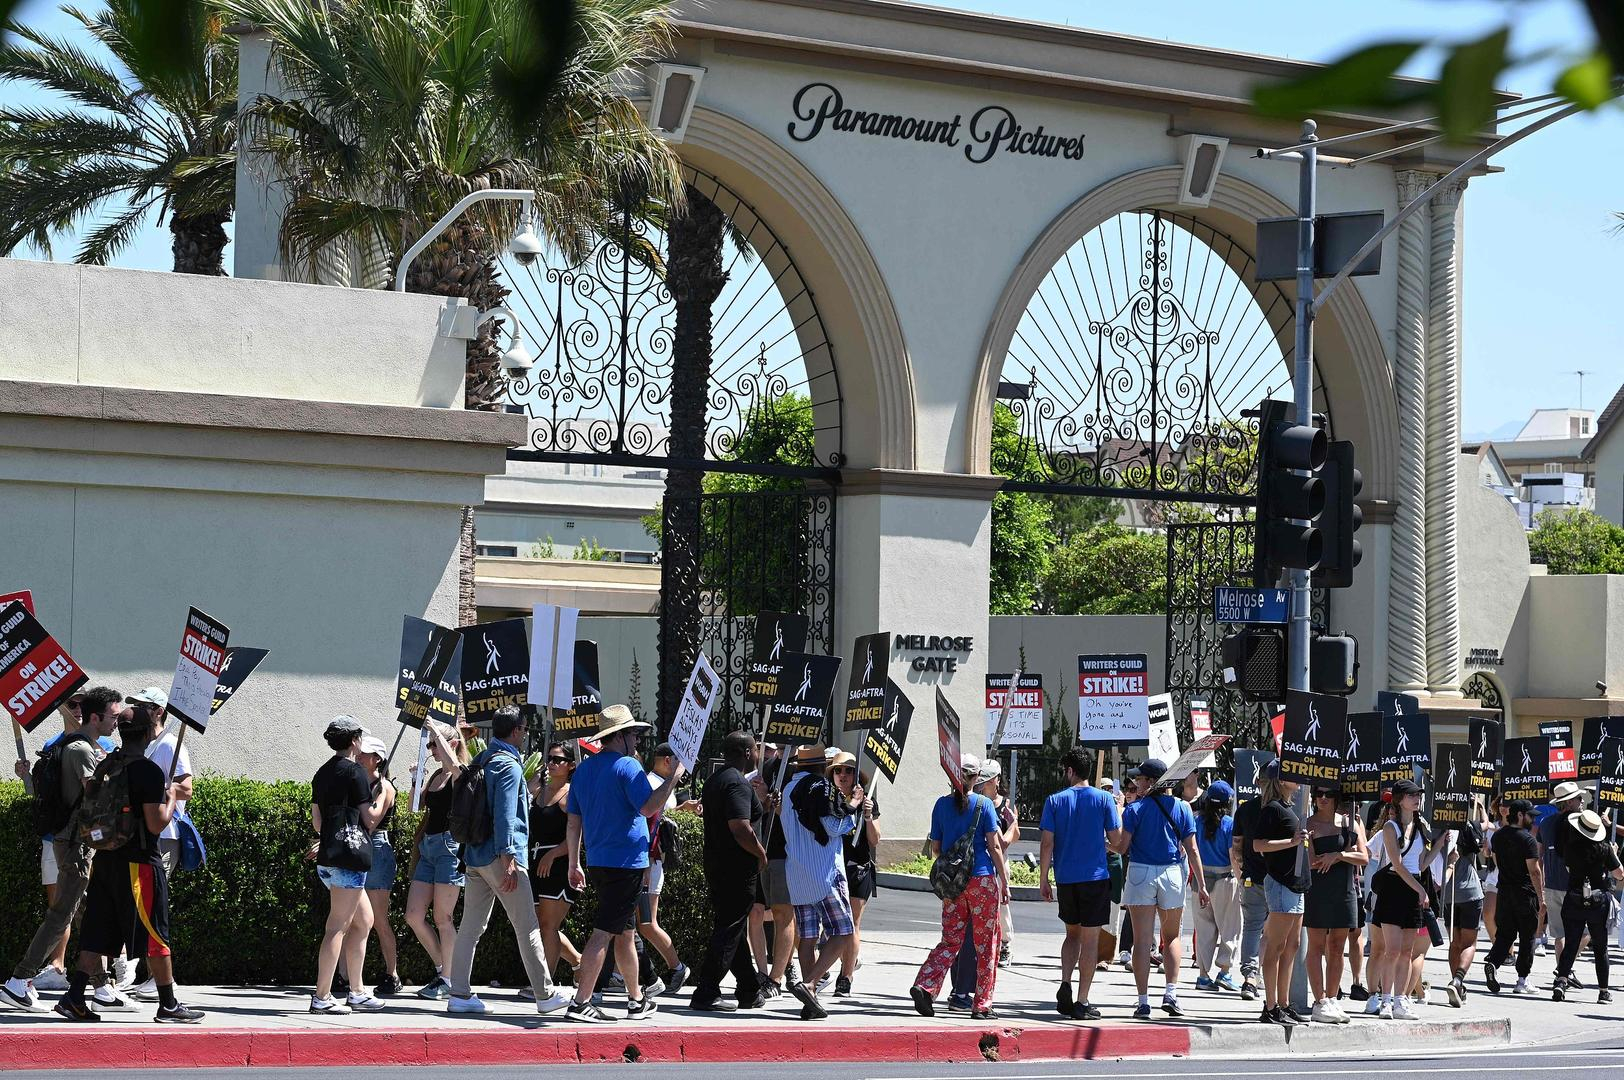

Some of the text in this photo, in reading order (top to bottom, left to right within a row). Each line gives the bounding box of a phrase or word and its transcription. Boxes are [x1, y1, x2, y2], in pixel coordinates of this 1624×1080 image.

[787, 83, 1085, 164] Paramount Pictures
[1219, 588, 1286, 608] Melrose Av
[1219, 607, 1251, 620] 5500 W
[1, 610, 26, 635] GUILD
[896, 634, 974, 652] MELROSE
[183, 633, 222, 673] STRIKE!
[1470, 647, 1499, 657] VISITOR
[912, 656, 957, 673] GATE
[1082, 660, 1143, 670] WRITERS GUILD
[1465, 657, 1505, 666] ENTRANCE
[19, 661, 38, 680] ON
[8, 654, 73, 717] STRIKE!
[767, 675, 777, 683] ON
[1020, 678, 1039, 687] GUILD
[1083, 676, 1144, 694] STRIKE!
[490, 688, 505, 697] ON
[466, 693, 528, 714] STRIKE
[1087, 698, 1133, 709] Oh you've
[566, 708, 576, 717] ON
[846, 706, 883, 721] STRIKE!
[1018, 710, 1040, 719] TIME
[554, 714, 600, 732] STRIKE!
[768, 720, 820, 739] STRIKE!
[1009, 720, 1025, 729] IT'S
[1082, 721, 1142, 731] done it now!
[866, 736, 897, 775] STRIKE!
[1303, 755, 1316, 764] ON
[1281, 759, 1339, 780] STRIKE!
[1548, 760, 1575, 774] STRIKE!
[1346, 773, 1358, 781] ON
[1470, 776, 1493, 788] TRIKE!
[1504, 789, 1548, 800] STRIKE!
[1433, 809, 1468, 821] STRIKE!
